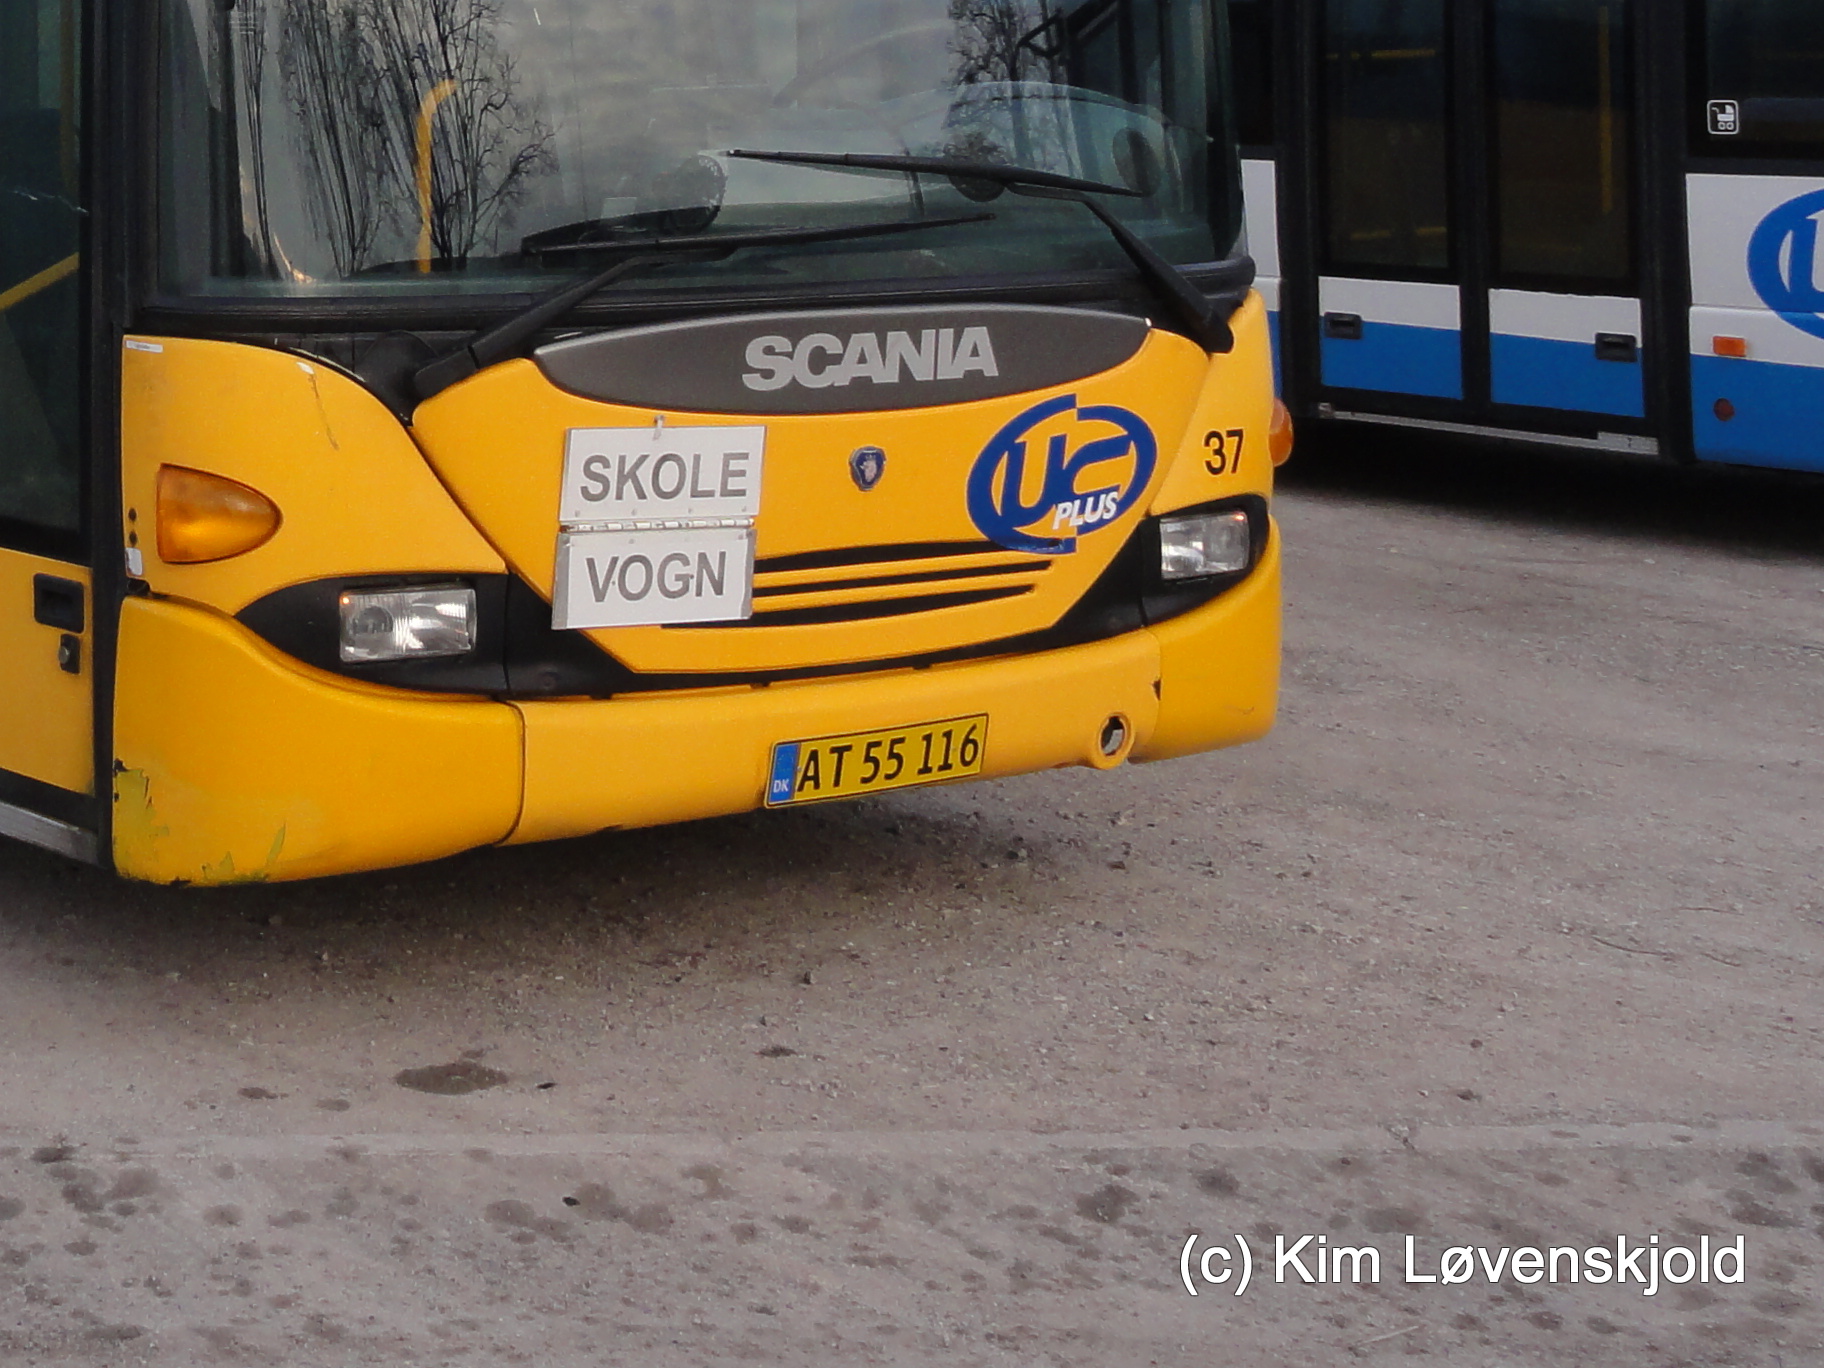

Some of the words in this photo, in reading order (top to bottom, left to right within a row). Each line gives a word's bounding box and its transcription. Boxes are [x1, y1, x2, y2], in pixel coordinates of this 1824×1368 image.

[742, 326, 999, 391] SCANIA
[1203, 428, 1244, 475] 37
[580, 452, 750, 502] SKOLE
[1052, 491, 1119, 531] PLUS
[586, 551, 726, 602] VOGN
[796, 744, 853, 792] AT
[860, 736, 907, 784] 55
[917, 723, 980, 776] 116
[773, 779, 789, 793] DK
